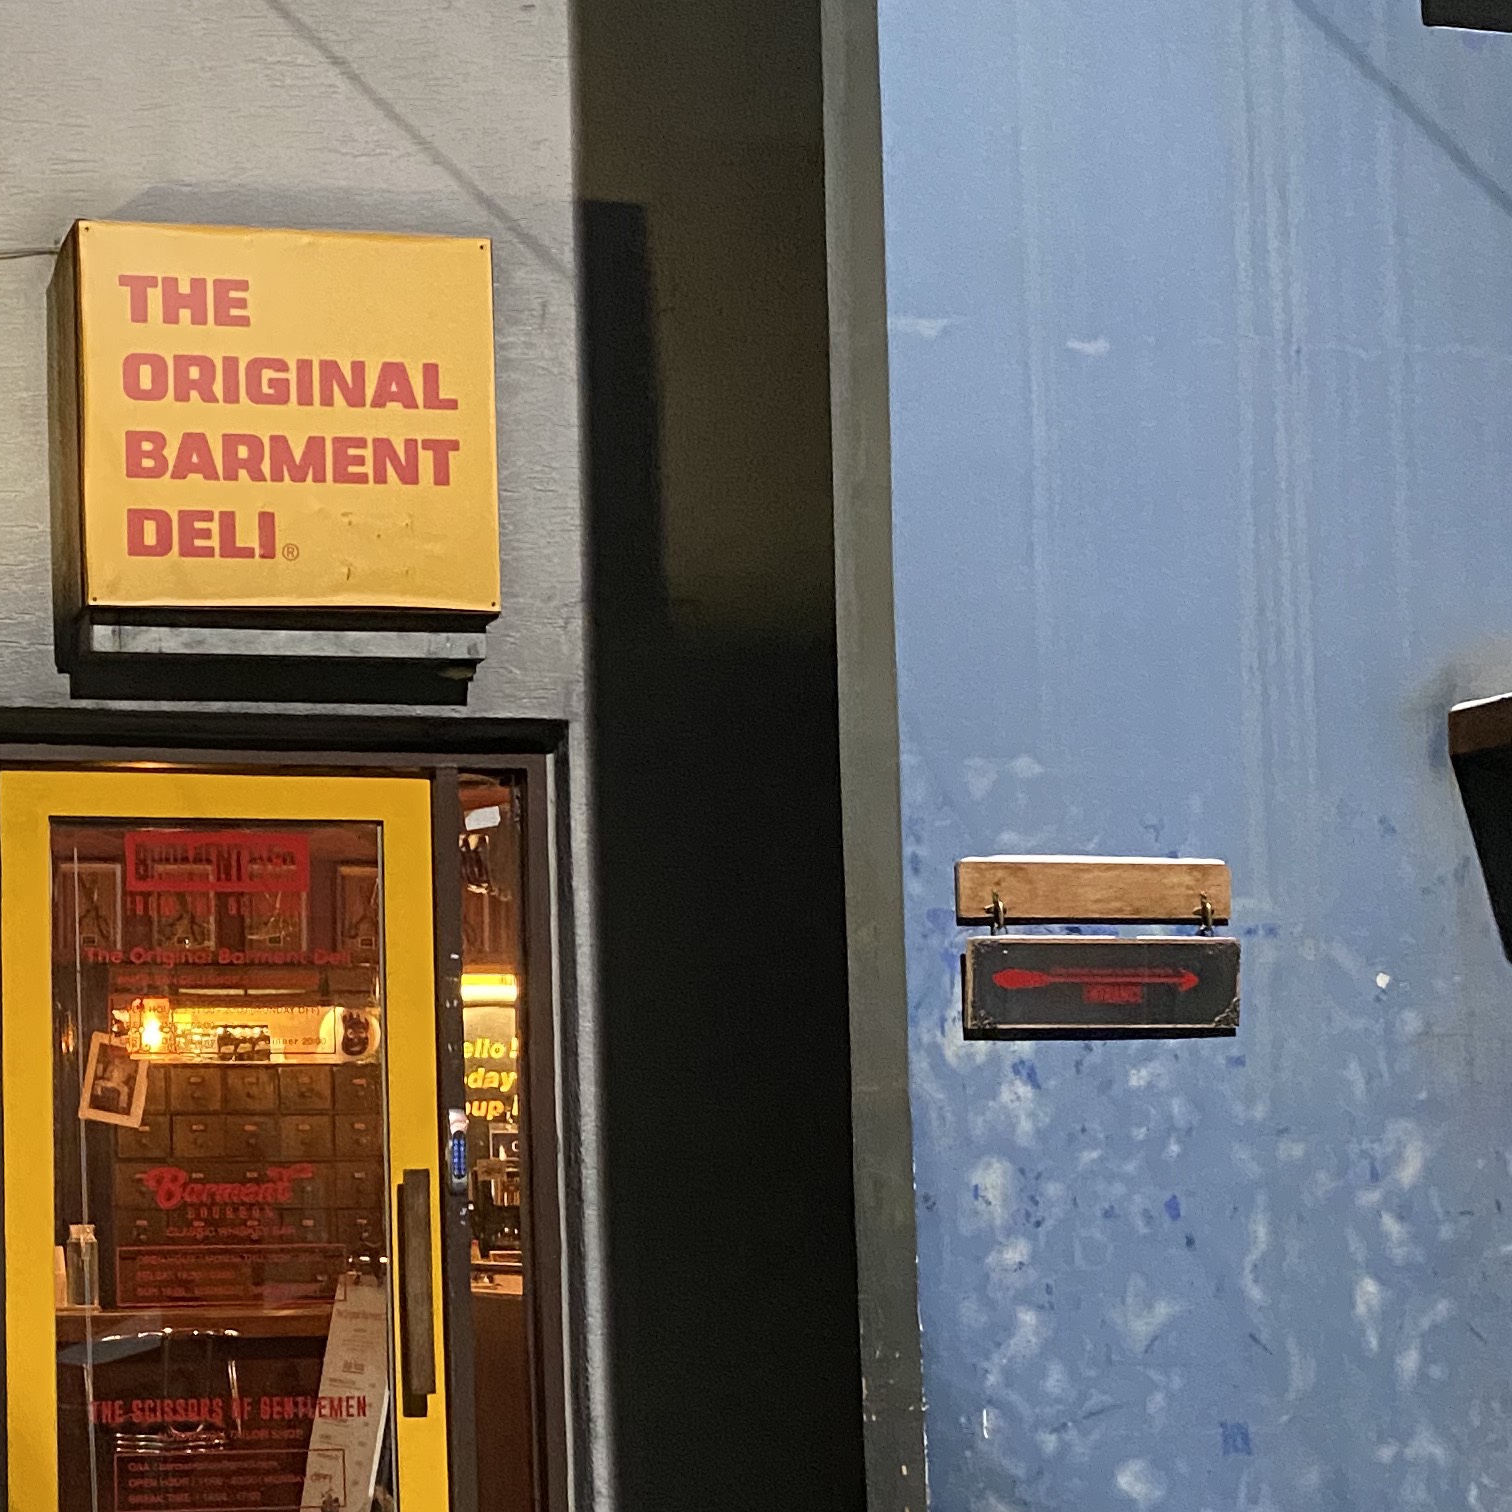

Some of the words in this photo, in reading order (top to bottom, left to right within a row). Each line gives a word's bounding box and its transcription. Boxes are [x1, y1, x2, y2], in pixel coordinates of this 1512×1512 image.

[118, 274, 251, 327] THE
[122, 353, 459, 410] ORIGINAL
[125, 430, 460, 486] BARMENT
[259, 1395, 367, 1421] GENTLEMEN
